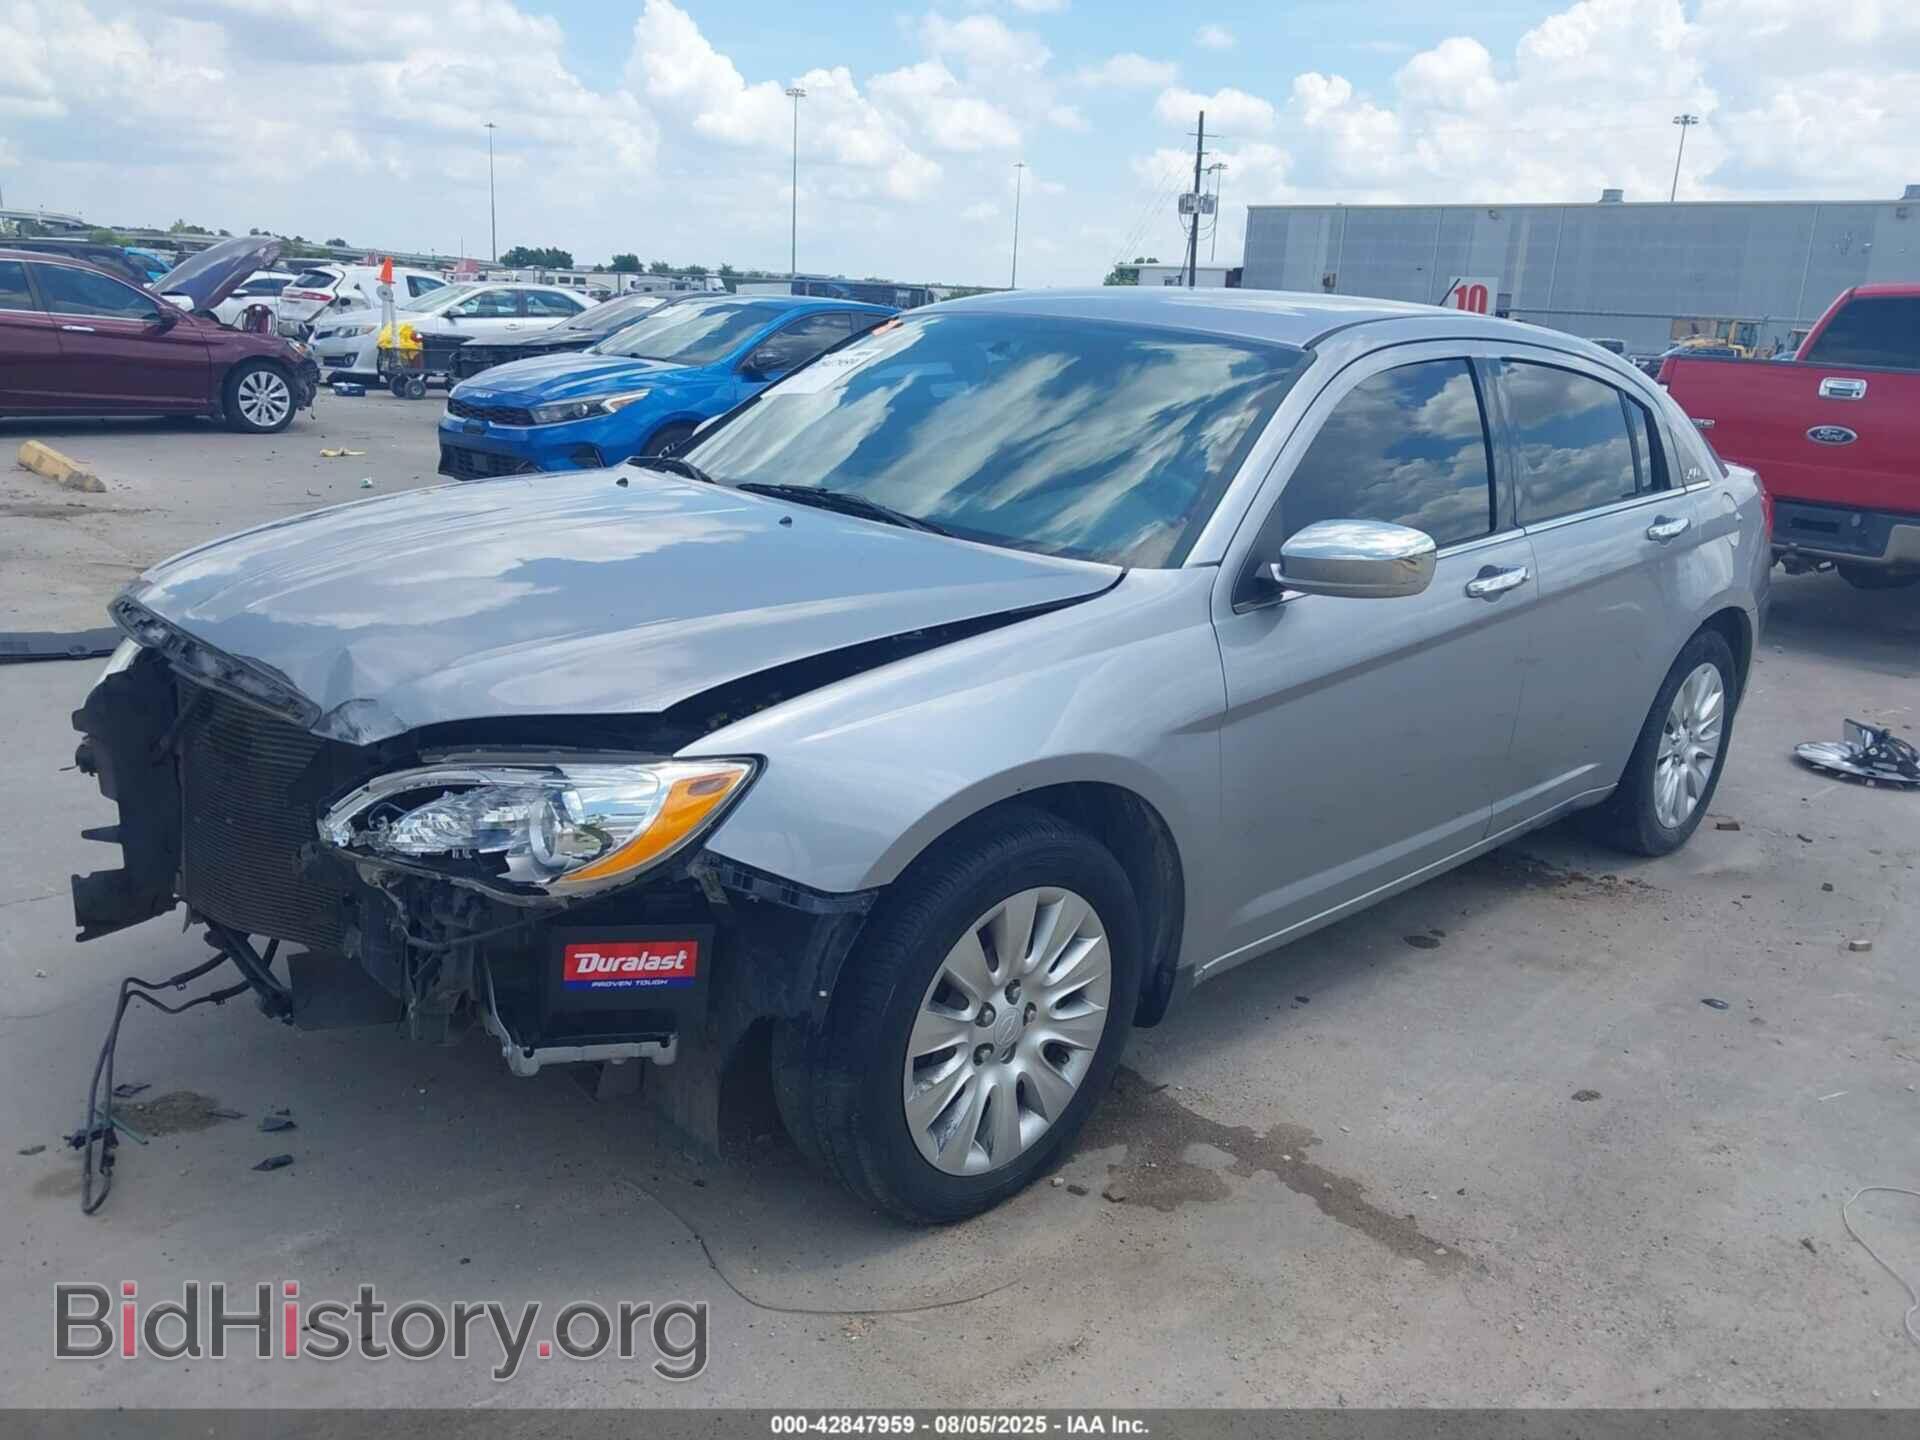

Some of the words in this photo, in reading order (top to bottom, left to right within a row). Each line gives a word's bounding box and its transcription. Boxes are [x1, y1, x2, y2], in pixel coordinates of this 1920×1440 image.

[1454, 284, 1488, 314] 10
[574, 949, 688, 973] Duralast
[591, 980, 633, 988] PROVEN
[635, 978, 669, 986] TOUGH
